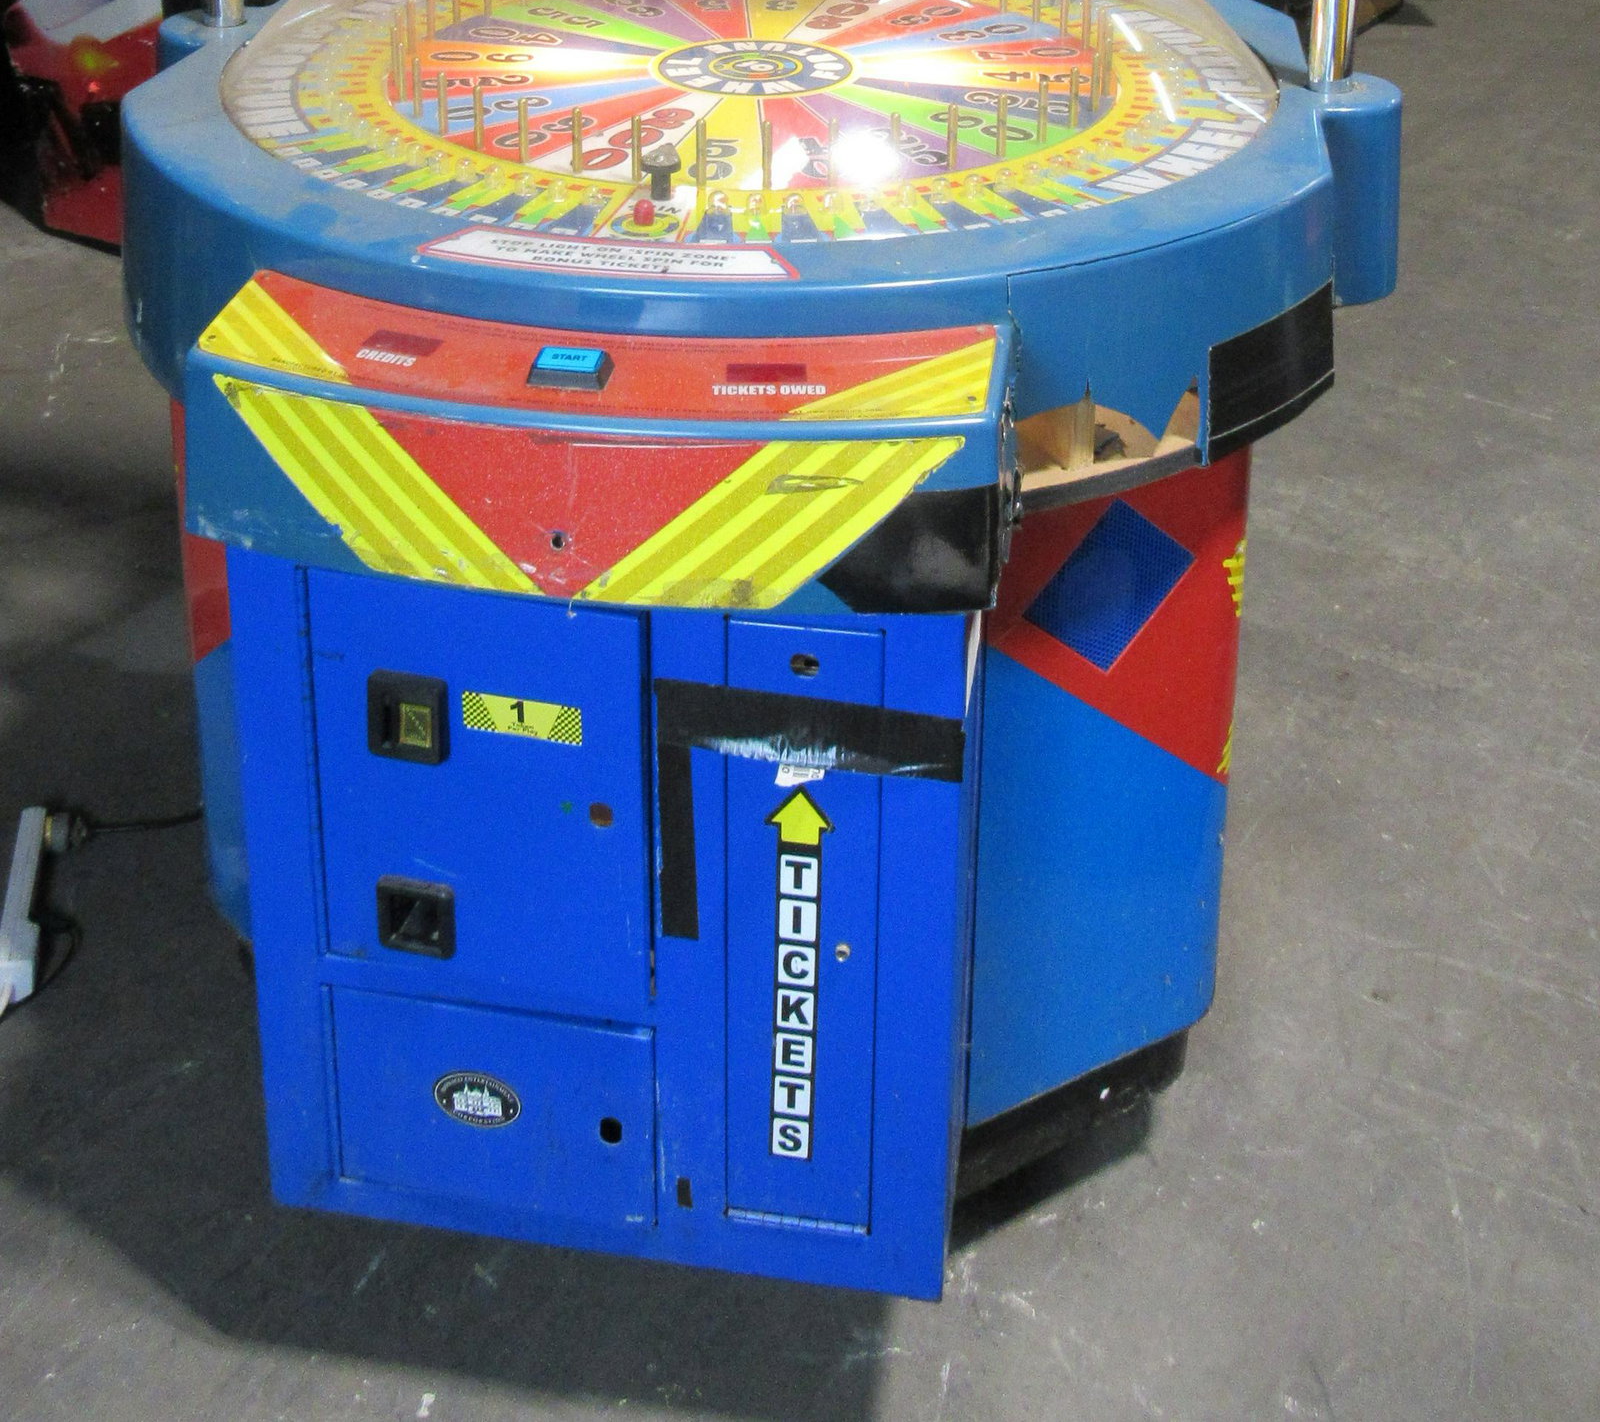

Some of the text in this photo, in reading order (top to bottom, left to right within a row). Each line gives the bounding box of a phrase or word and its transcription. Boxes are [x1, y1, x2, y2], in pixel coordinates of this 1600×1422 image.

[540, 242, 591, 251] LIGHT
[523, 248, 574, 256] MAKE
[581, 252, 634, 261] WHEEL
[532, 256, 593, 264] BONUS
[356, 348, 417, 367] CREDITS
[551, 353, 588, 362] START
[711, 385, 827, 396] TICKETS OWED
[510, 700, 525, 723] 1
[778, 860, 813, 1152] TICKETS
